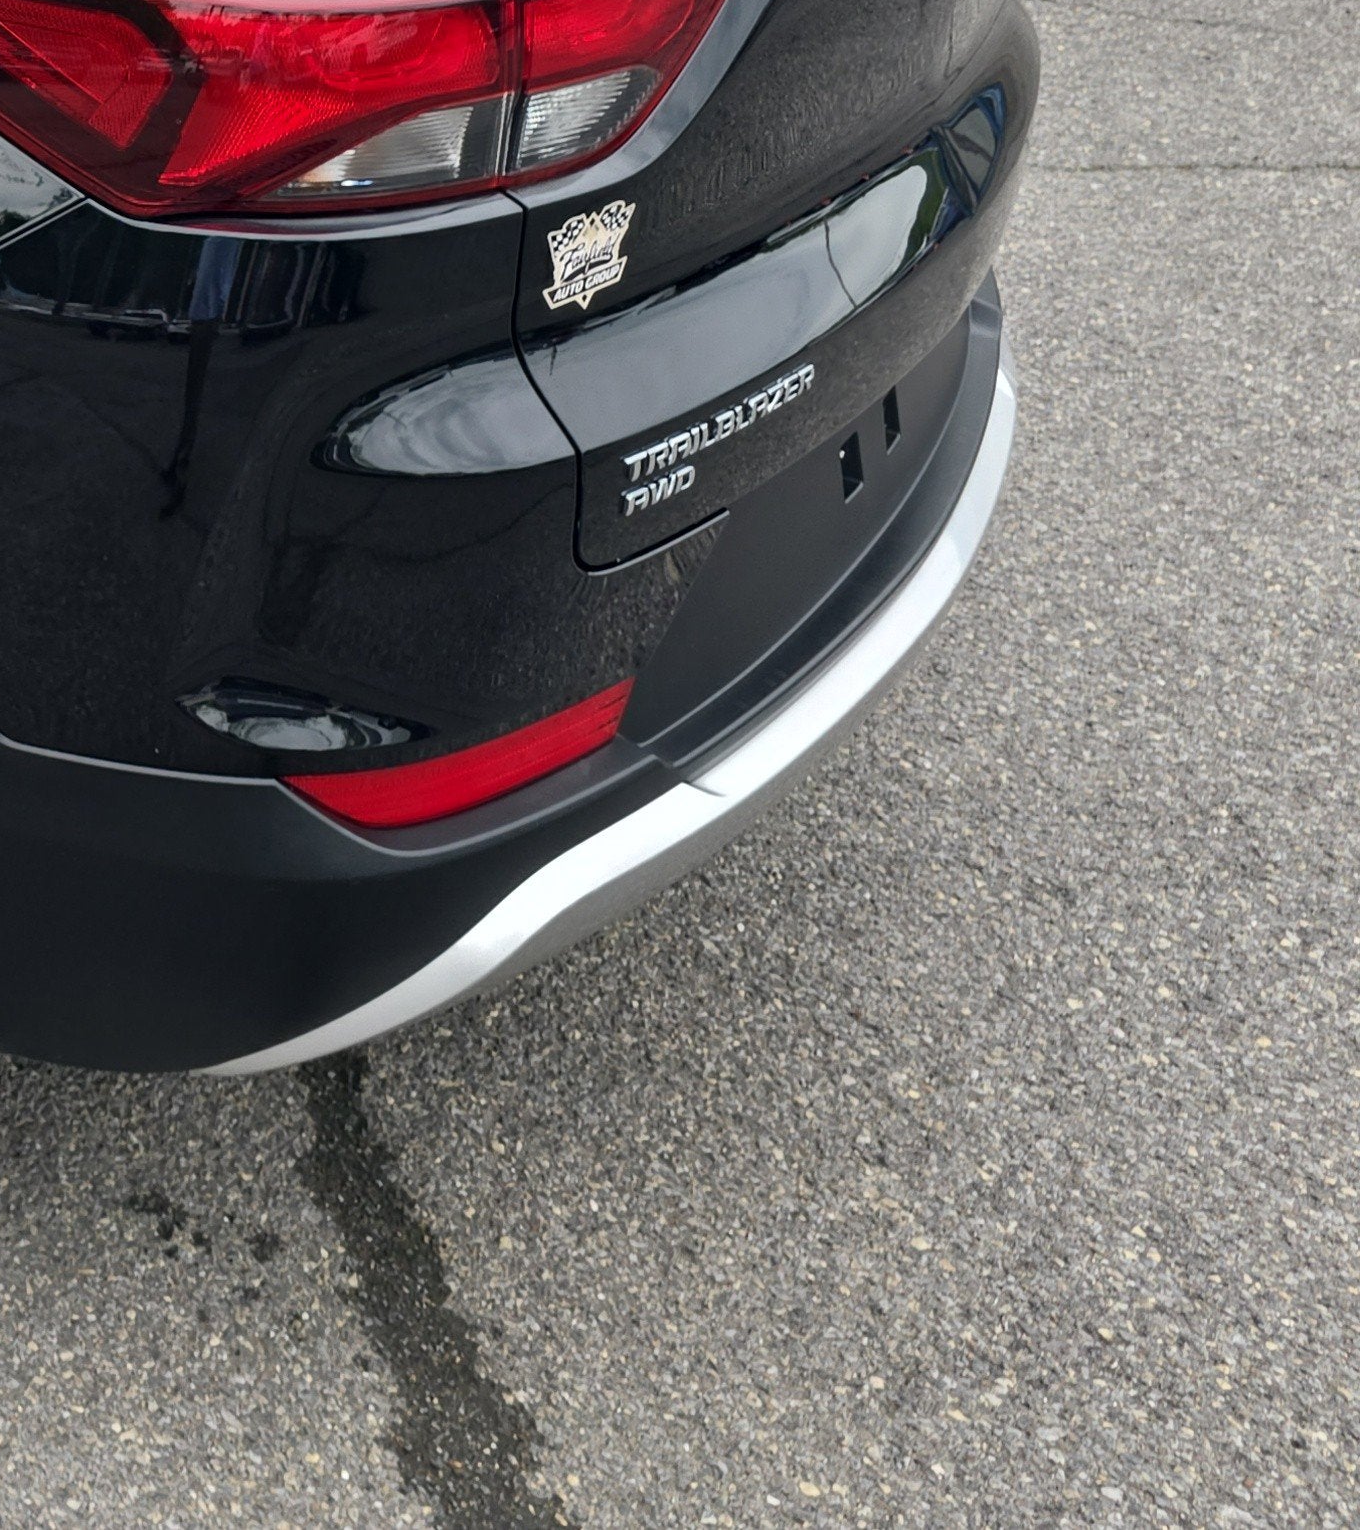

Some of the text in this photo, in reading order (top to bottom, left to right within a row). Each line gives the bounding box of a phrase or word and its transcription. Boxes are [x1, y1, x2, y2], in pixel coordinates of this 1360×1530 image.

[553, 263, 621, 303] AUTO GROUP
[622, 363, 815, 483] TRAILBLAZER
[622, 464, 696, 517] AWD
